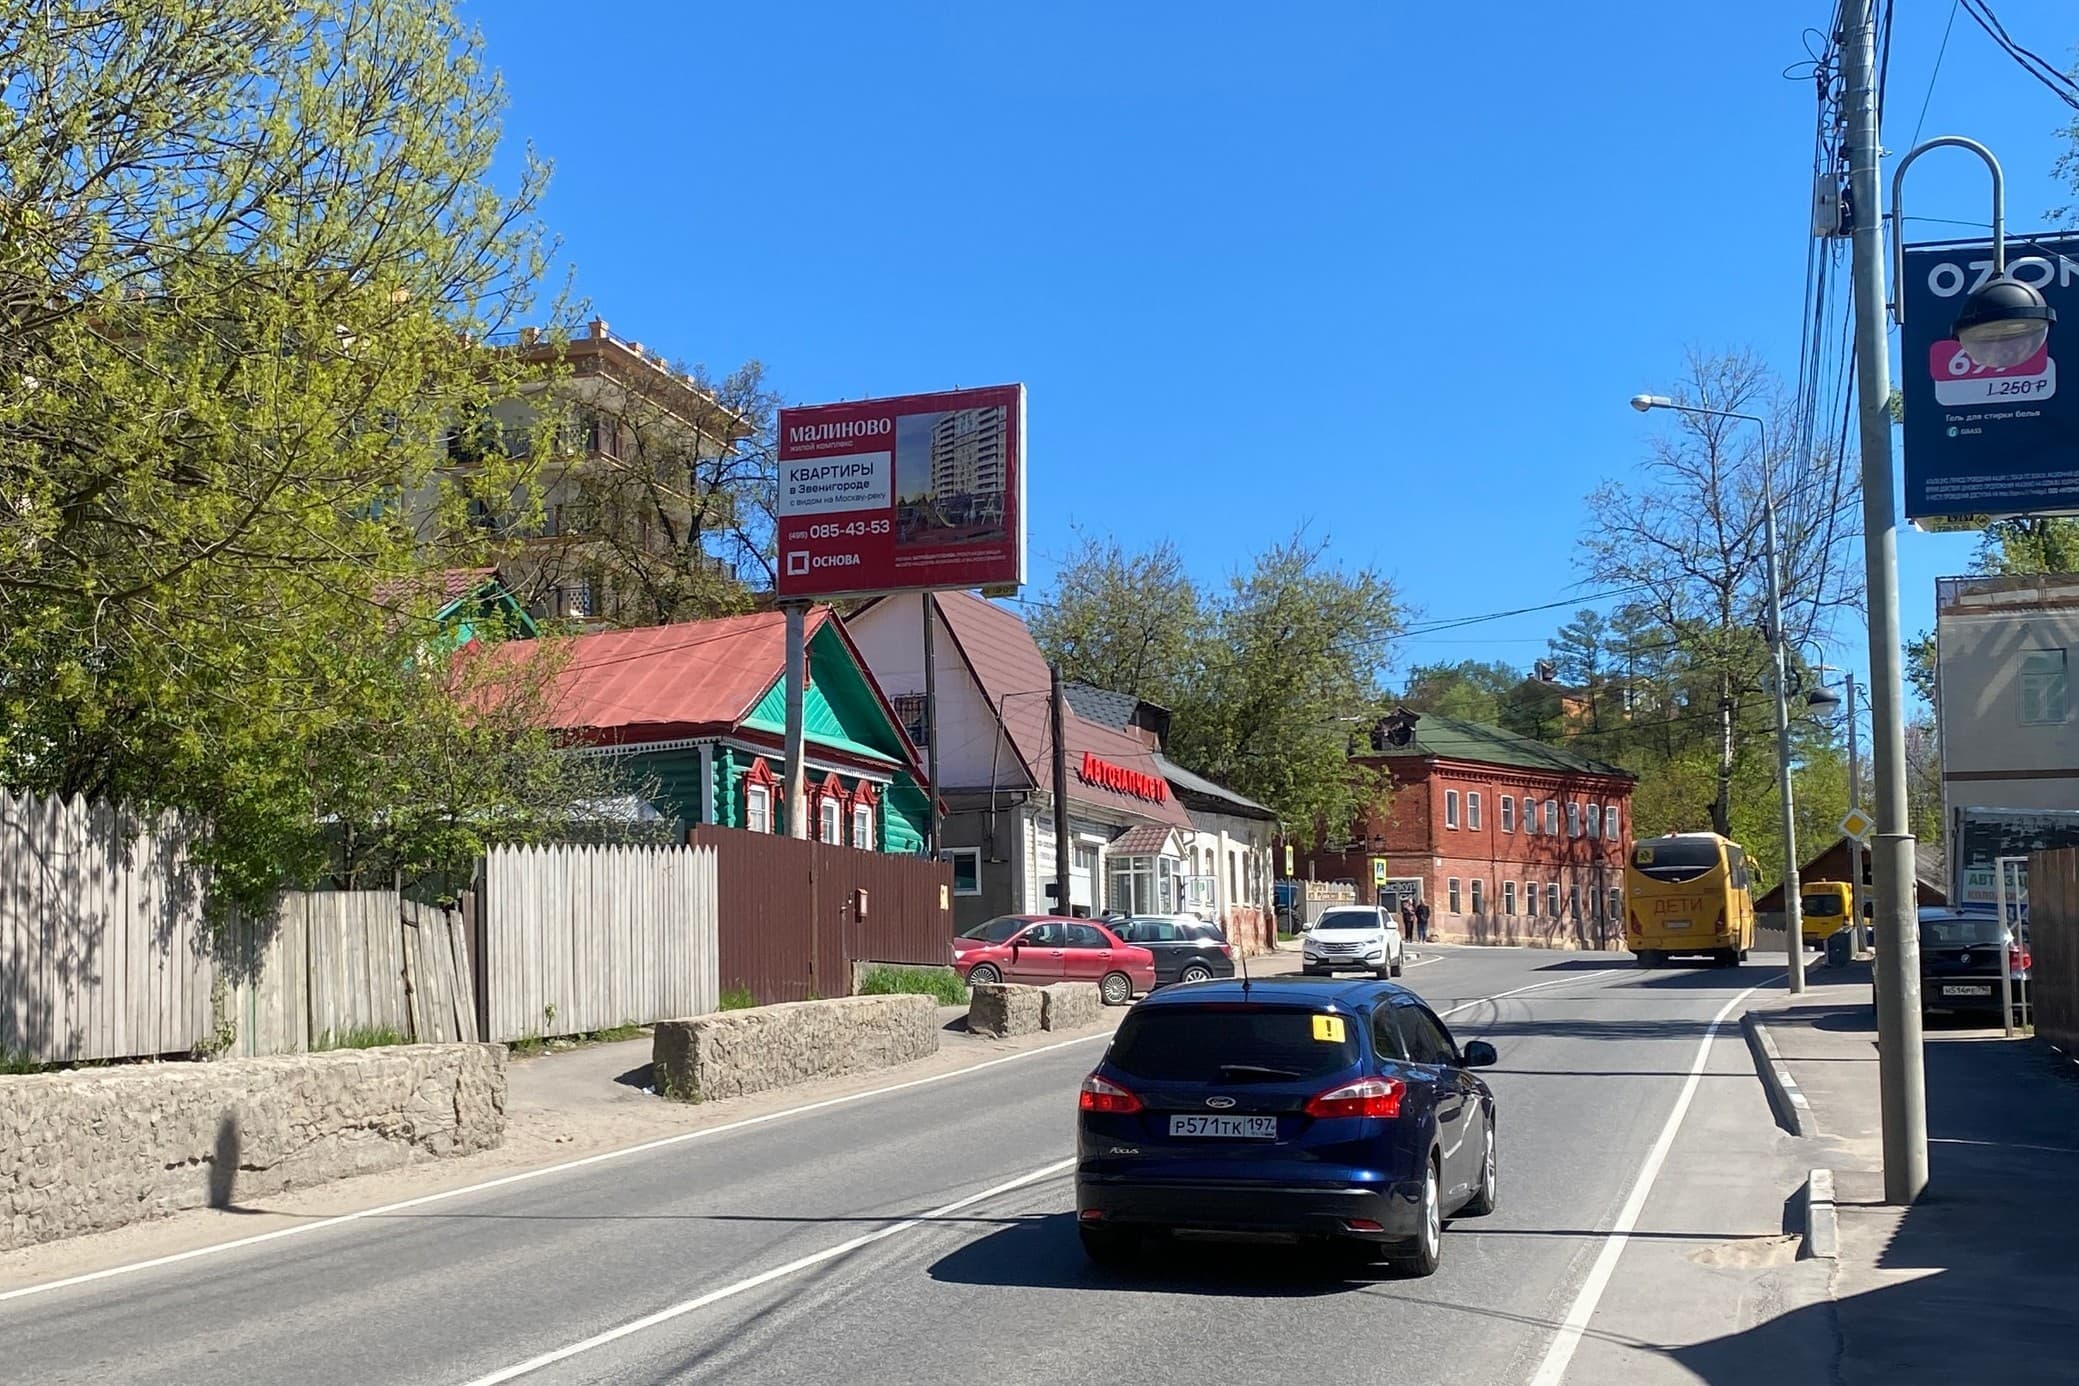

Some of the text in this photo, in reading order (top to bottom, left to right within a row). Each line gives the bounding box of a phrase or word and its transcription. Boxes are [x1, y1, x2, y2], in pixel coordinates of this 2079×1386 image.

[2000, 380, 2031, 395] 250
[1945, 414, 1964, 422] Гель
[1984, 412, 2014, 420] стирки
[2016, 409, 2041, 417] белья
[816, 440, 854, 450] комплекс
[790, 462, 873, 482] КВАРТИРЫ
[798, 481, 870, 494] Звенигороде
[797, 497, 822, 506] видом
[824, 496, 833, 504] на
[835, 492, 887, 502] Москву-реку
[809, 519, 890, 539] 085-43-53
[812, 554, 861, 568] ОСНОВА
[1655, 898, 1703, 916] ДЕТИ
[1175, 1117, 1273, 1135] Р571ТК 197
